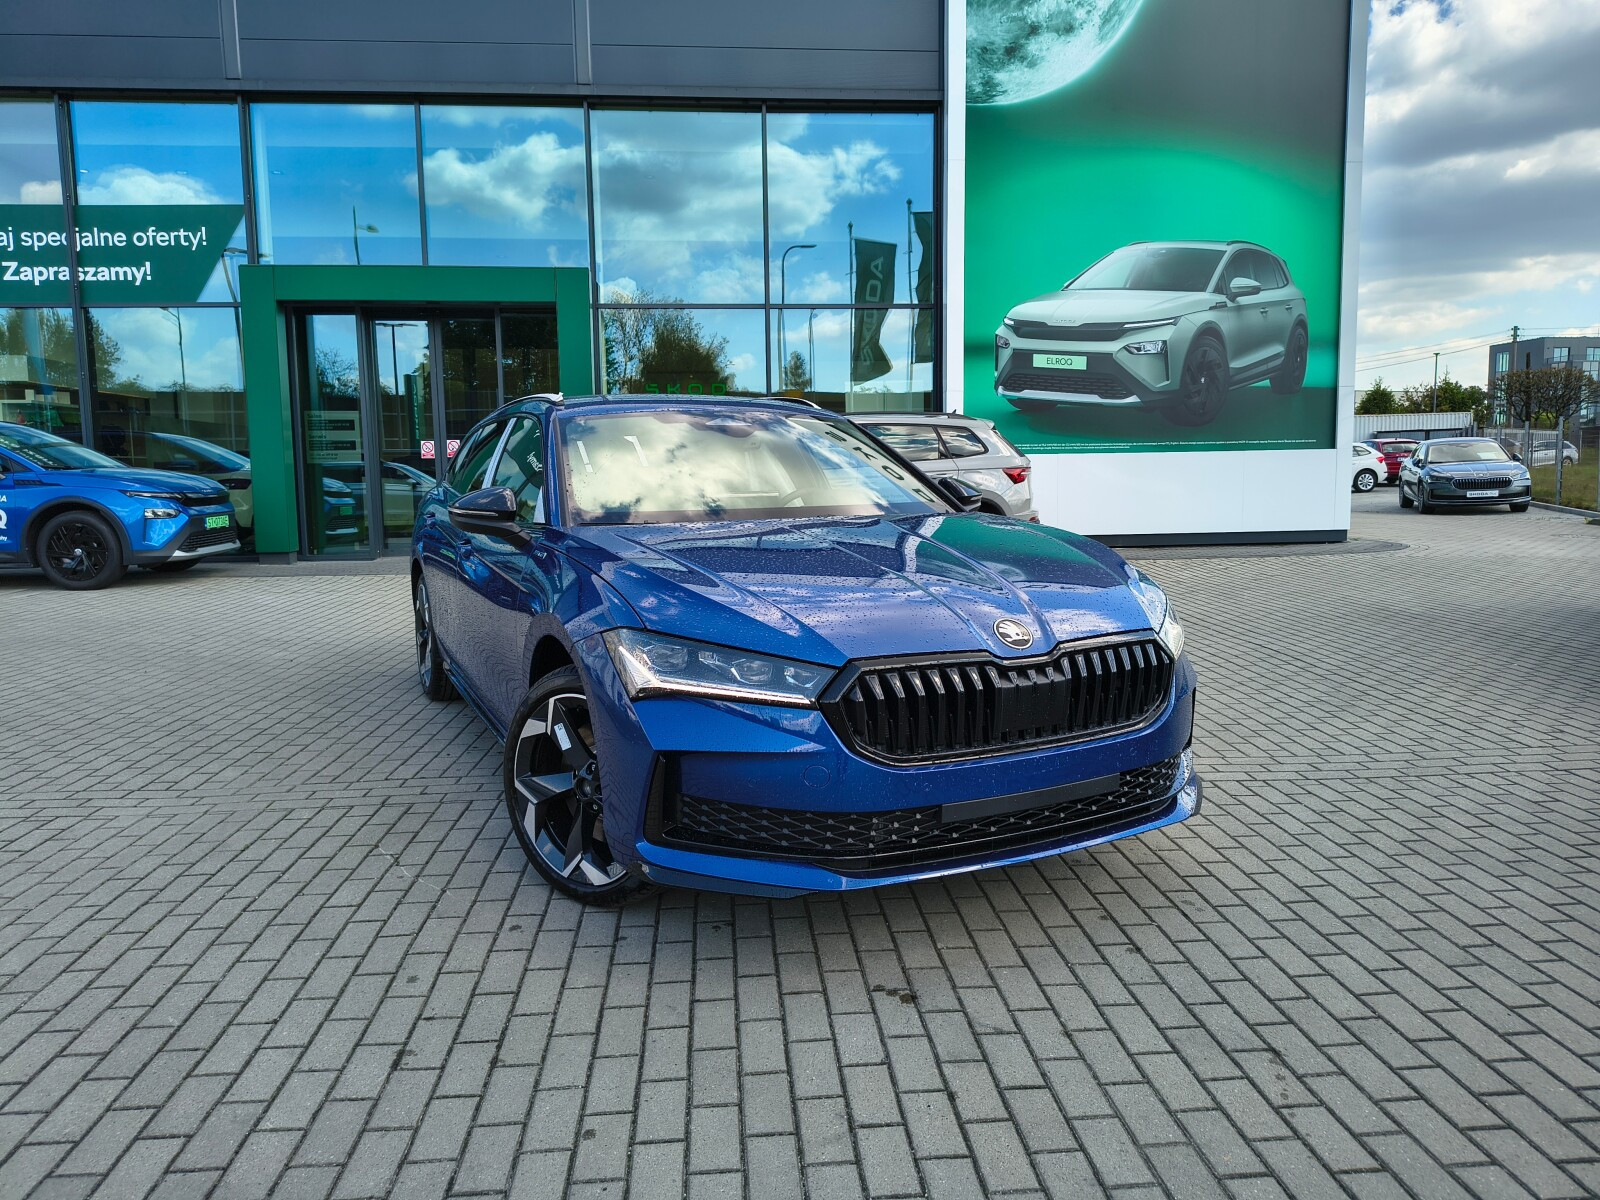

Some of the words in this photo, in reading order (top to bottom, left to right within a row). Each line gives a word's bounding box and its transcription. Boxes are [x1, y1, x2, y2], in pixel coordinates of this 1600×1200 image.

[132, 226, 207, 251] oferty!
[1, 261, 152, 286] Zapraszamy!
[1046, 357, 1073, 366] ELROQ
